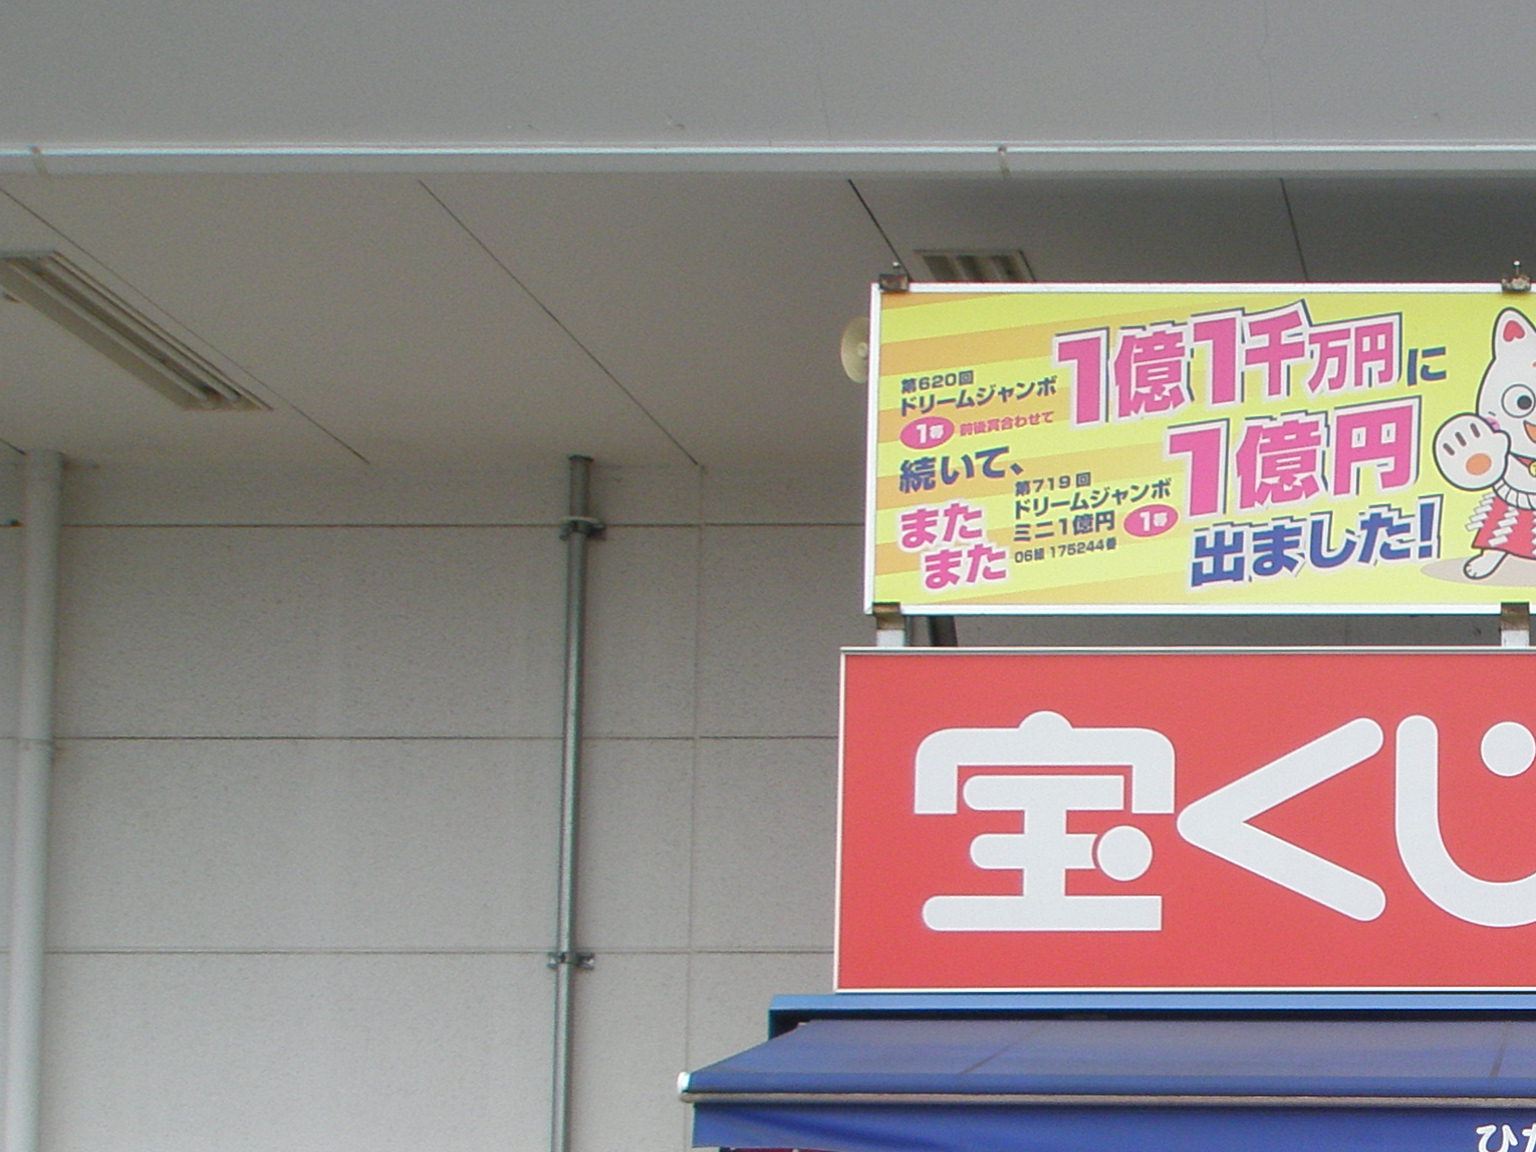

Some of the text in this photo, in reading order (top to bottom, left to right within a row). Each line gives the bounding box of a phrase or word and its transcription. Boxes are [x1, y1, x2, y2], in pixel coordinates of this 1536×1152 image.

[901, 370, 974, 394] 第620回
[901, 375, 1058, 417] ドリームジャンボ
[899, 446, 1024, 493] 続いて、
[1168, 404, 1414, 518] 1億円
[1014, 477, 1172, 519] ドリームジャンボ
[901, 503, 982, 548] また
[1013, 510, 1116, 542] ミニ1億円
[1190, 498, 1437, 588] 出ました!
[925, 544, 1006, 589] また
